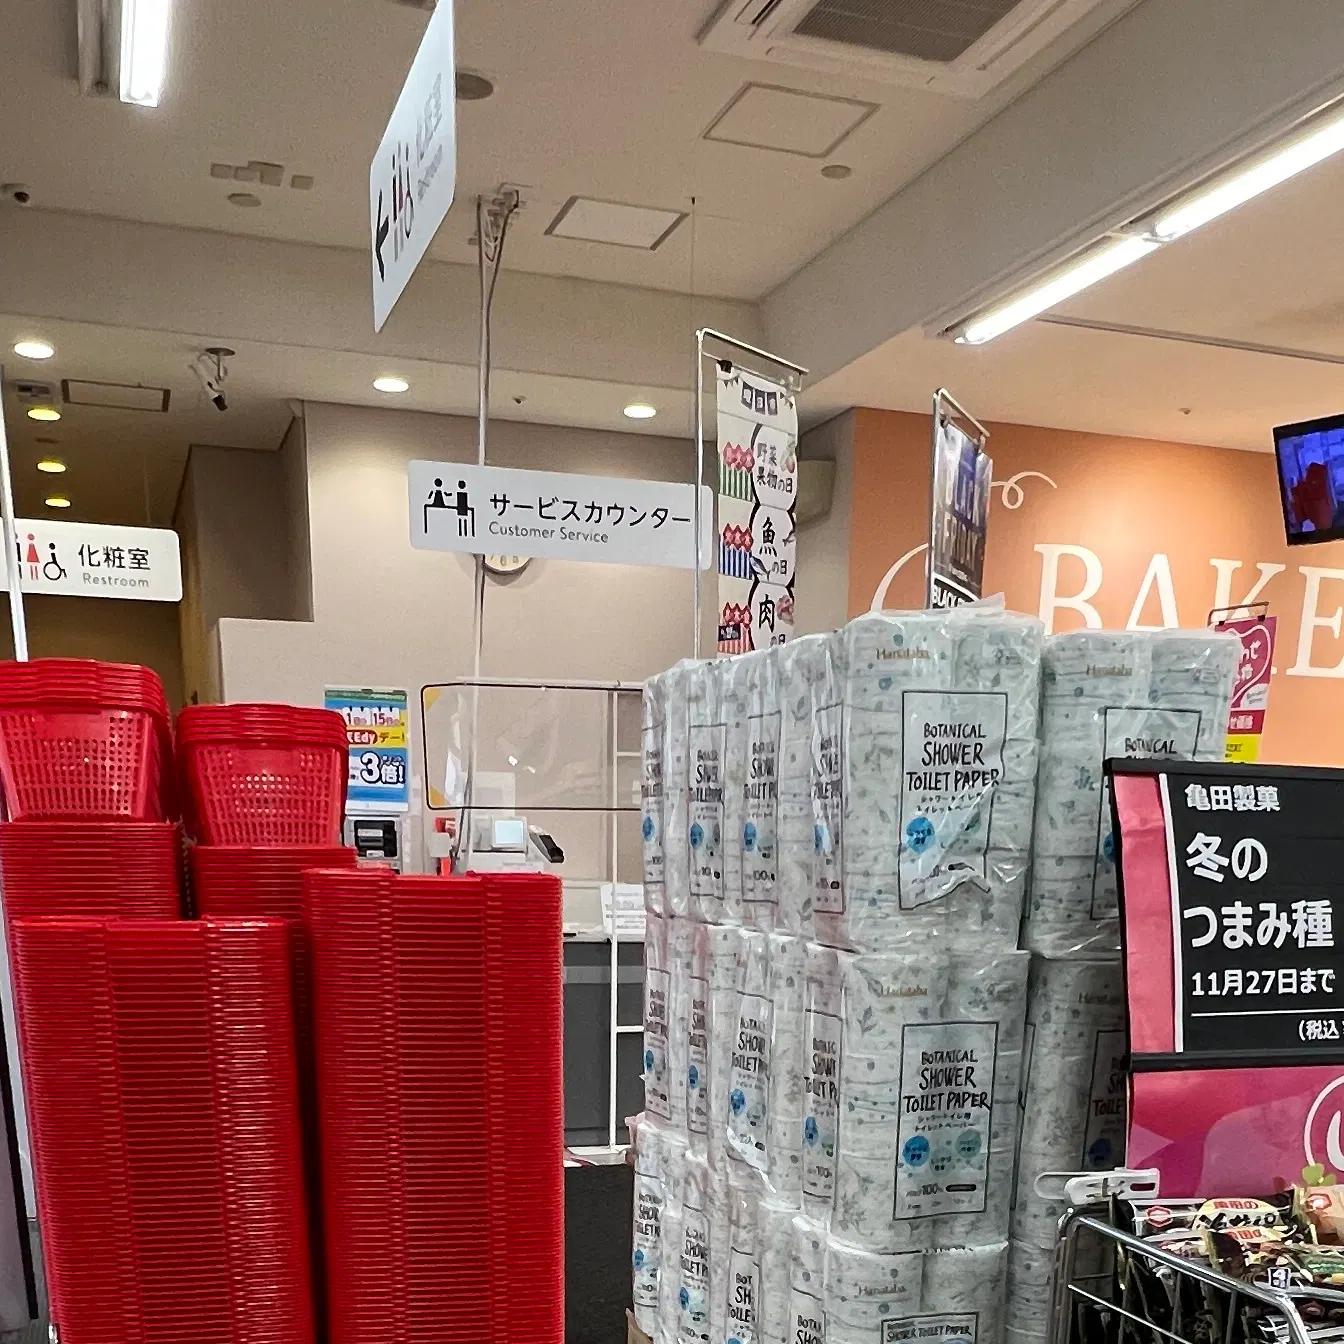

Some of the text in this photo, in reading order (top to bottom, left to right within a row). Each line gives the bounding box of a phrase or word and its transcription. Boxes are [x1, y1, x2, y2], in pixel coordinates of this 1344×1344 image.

[756, 442, 778, 466] 野菜
[756, 468, 793, 494] 果物の日
[487, 491, 693, 531] サービスカウンター
[488, 521, 610, 545] Customer Service
[760, 516, 777, 557] 魚
[78, 543, 152, 574] 化粧室
[82, 572, 151, 590] Restroom
[758, 593, 776, 633] 肉
[924, 722, 987, 739] BOTANICAL
[922, 741, 985, 767] SHOWER
[906, 768, 1000, 793] TOILET PAPER
[1184, 783, 1281, 812] 亀田製菓
[1186, 832, 1268, 883] 冬の
[1183, 899, 1335, 949] つまみ種
[1191, 968, 1336, 997] 11月27日まで
[921, 1048, 978, 1065] BOTANICAL
[919, 1066, 976, 1090] SHOWER
[903, 1091, 991, 1113] TOILET PAPER
